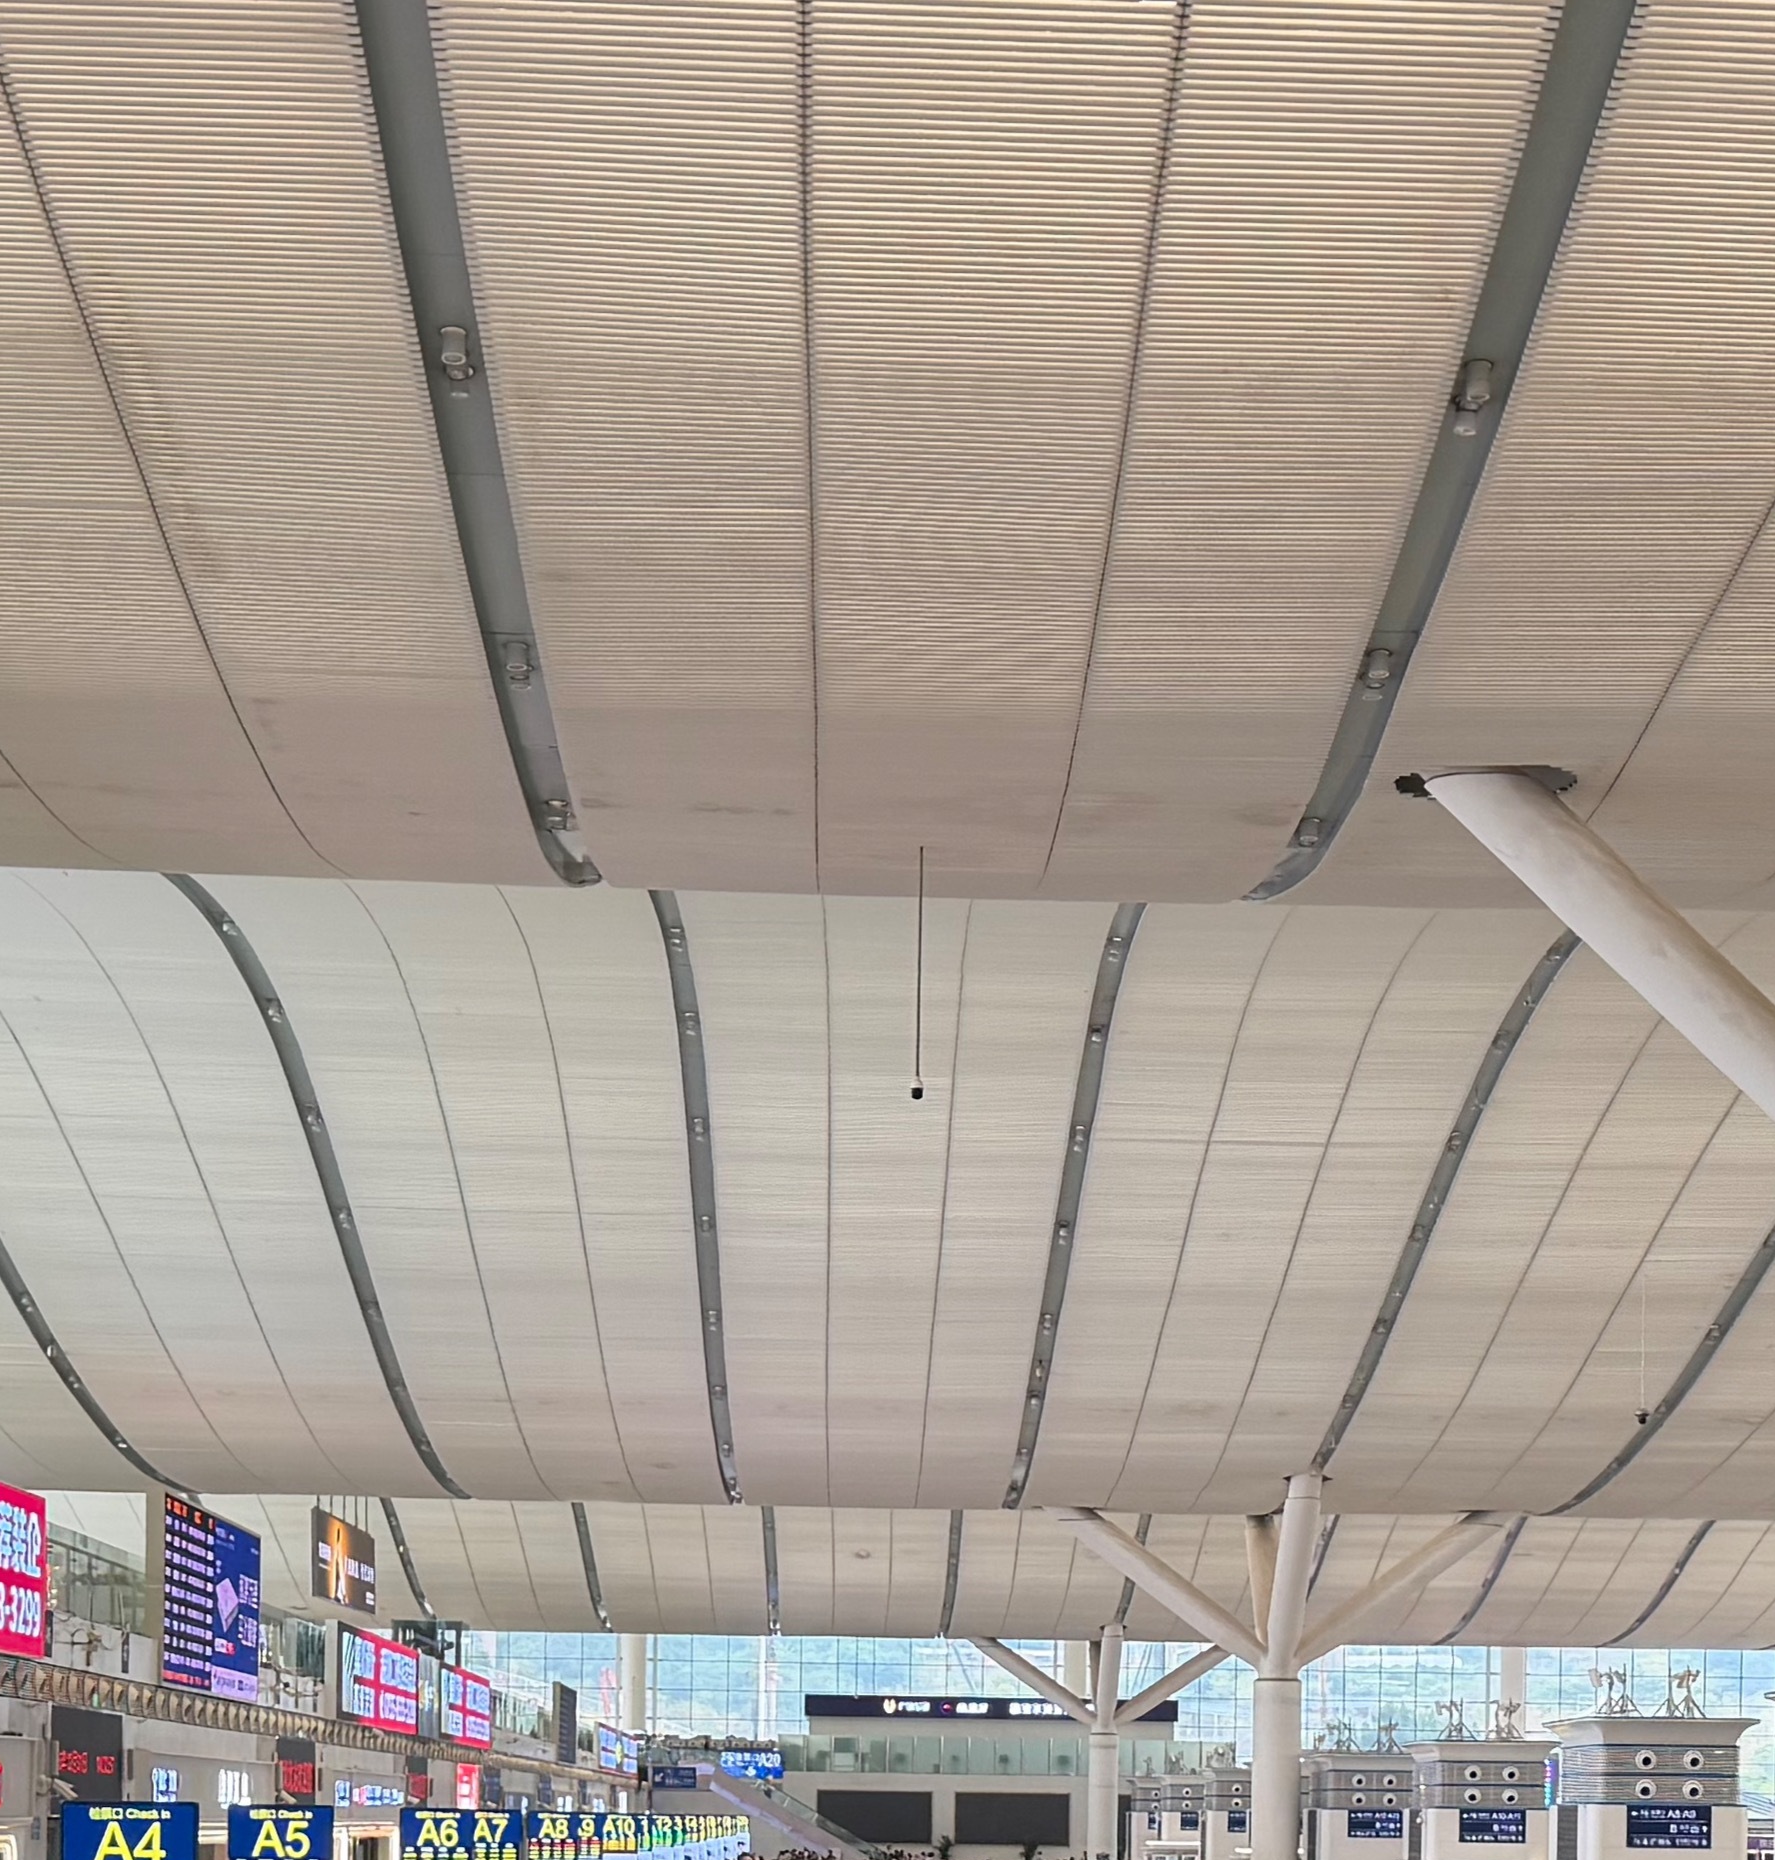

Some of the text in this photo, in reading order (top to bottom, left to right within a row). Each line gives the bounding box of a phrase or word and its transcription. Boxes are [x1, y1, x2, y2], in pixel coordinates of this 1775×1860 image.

[251, 1819, 311, 1859] A5
[416, 1817, 459, 1848] A6
[473, 1817, 509, 1844] A7
[538, 1818, 570, 1840] A8
[602, 1819, 636, 1838] A10
